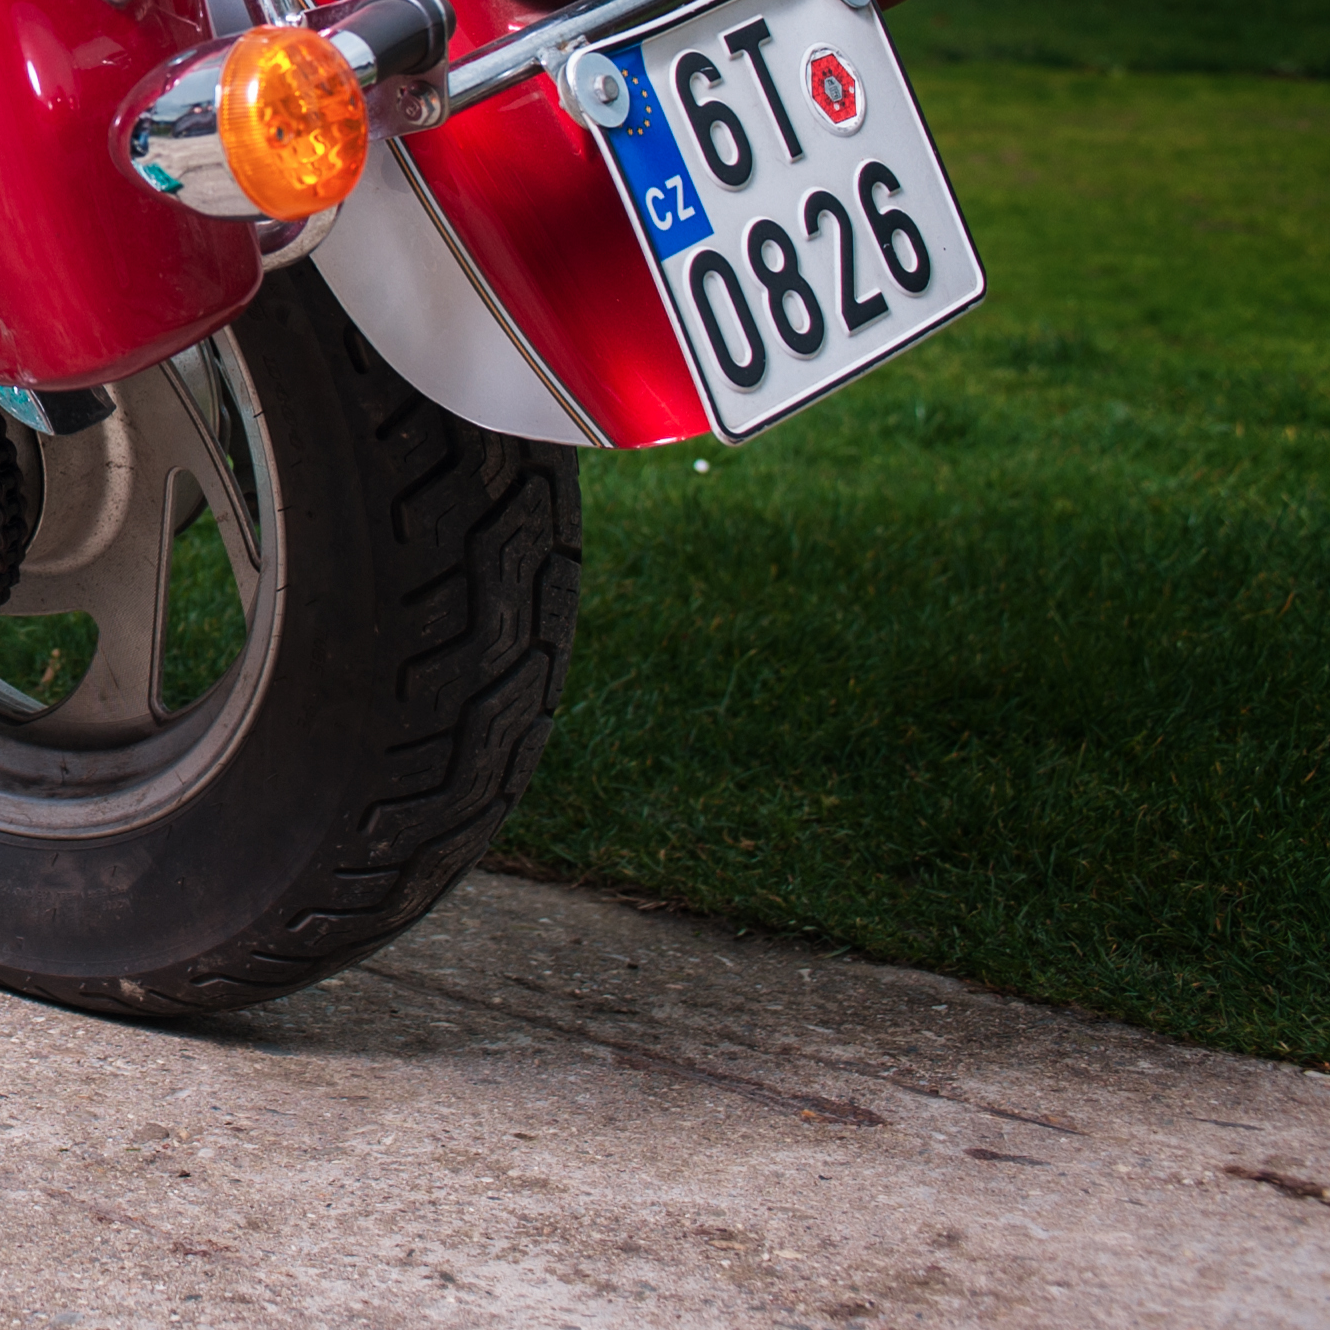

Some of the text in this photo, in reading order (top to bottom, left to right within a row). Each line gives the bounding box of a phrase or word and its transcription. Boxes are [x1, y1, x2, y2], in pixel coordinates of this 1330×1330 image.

[674, 16, 803, 187] 6T
[645, 175, 696, 231] CZ
[687, 160, 932, 389] 0826
